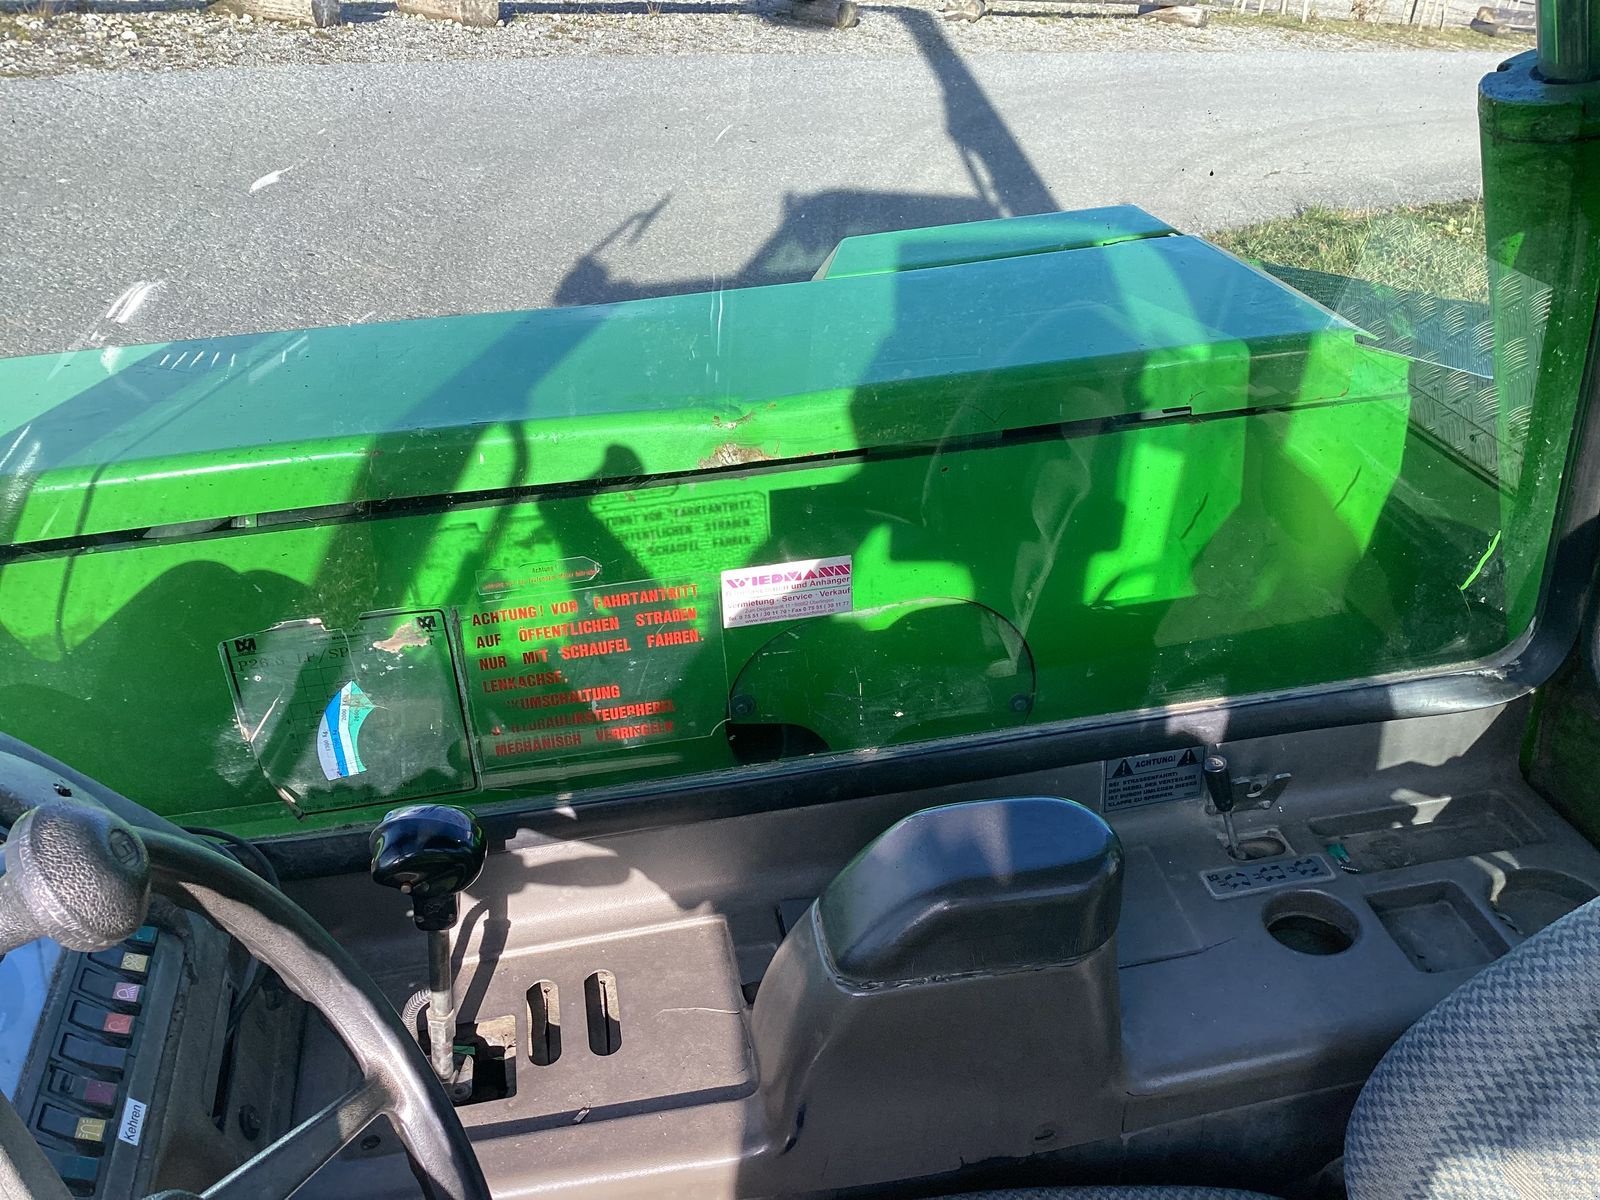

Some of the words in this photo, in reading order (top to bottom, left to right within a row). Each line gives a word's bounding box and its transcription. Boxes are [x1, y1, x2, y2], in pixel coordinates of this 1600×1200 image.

[726, 563, 851, 588] WIEDMANN
[791, 580, 808, 590] und
[810, 576, 851, 588] Anhänger
[472, 605, 545, 628] ACHTUNG!
[551, 600, 580, 617] VOR
[592, 583, 697, 610] FAHRTANTRITT
[781, 592, 813, 602] Service
[819, 586, 851, 597] Verkauf
[477, 633, 503, 651] AUF
[519, 615, 620, 643] ÖFFENTLICHEN
[479, 656, 508, 673] NUR
[522, 649, 549, 666] MIT
[561, 637, 632, 661] SCHAUFEL
[646, 628, 703, 648] FAHREN.
[495, 733, 584, 758] MECHANISCH
[595, 720, 676, 743] VERRIEGELN
[1135, 754, 1176, 769] ACHTUNG!
[123, 1104, 142, 1142] Kehren
